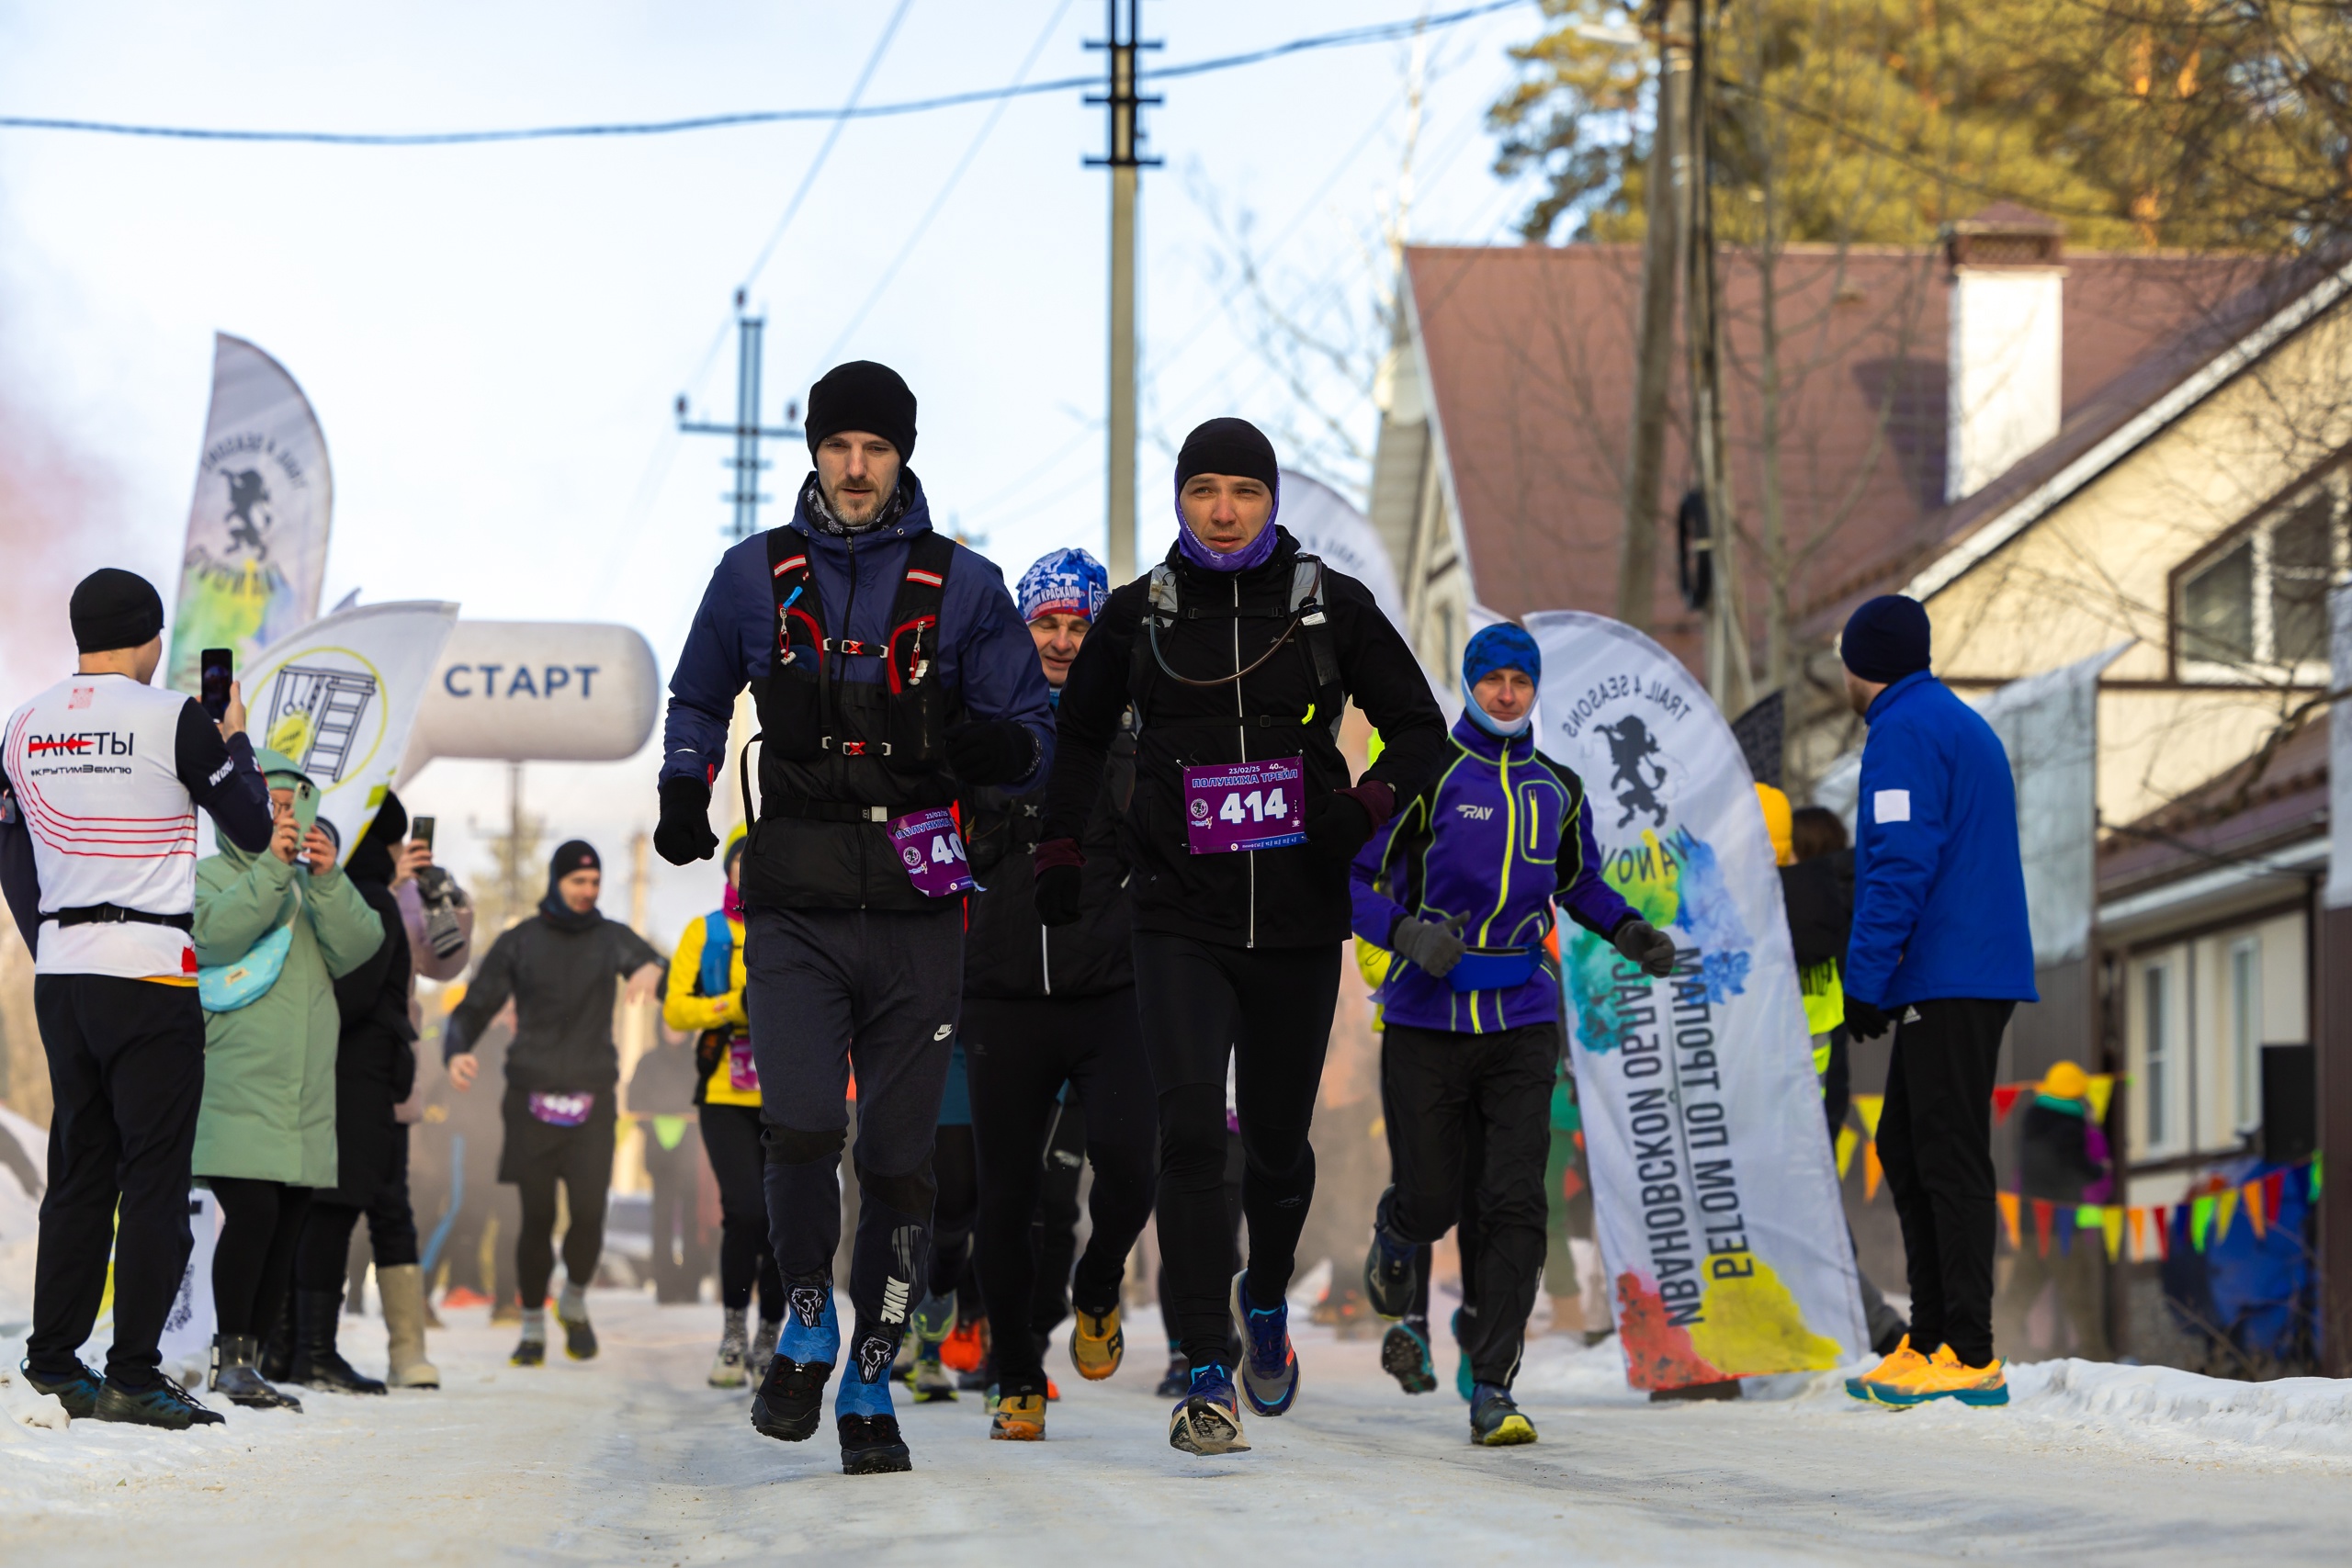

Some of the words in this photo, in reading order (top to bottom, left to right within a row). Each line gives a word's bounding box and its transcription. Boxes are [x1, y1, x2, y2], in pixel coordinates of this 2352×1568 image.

[443, 663, 602, 699] СТАРТ
[28, 731, 134, 759] РАКЕТЫ
[1192, 773, 1260, 788] ПОЛУНИХА
[1260, 767, 1298, 783] ТРЕЙЛ
[1228, 765, 1261, 774] 23/02/25
[1219, 787, 1288, 824] 414
[1456, 804, 1494, 820] RAY
[895, 818, 952, 840] ПОЛУНИХА
[880, 1275, 910, 1325] NIKE
